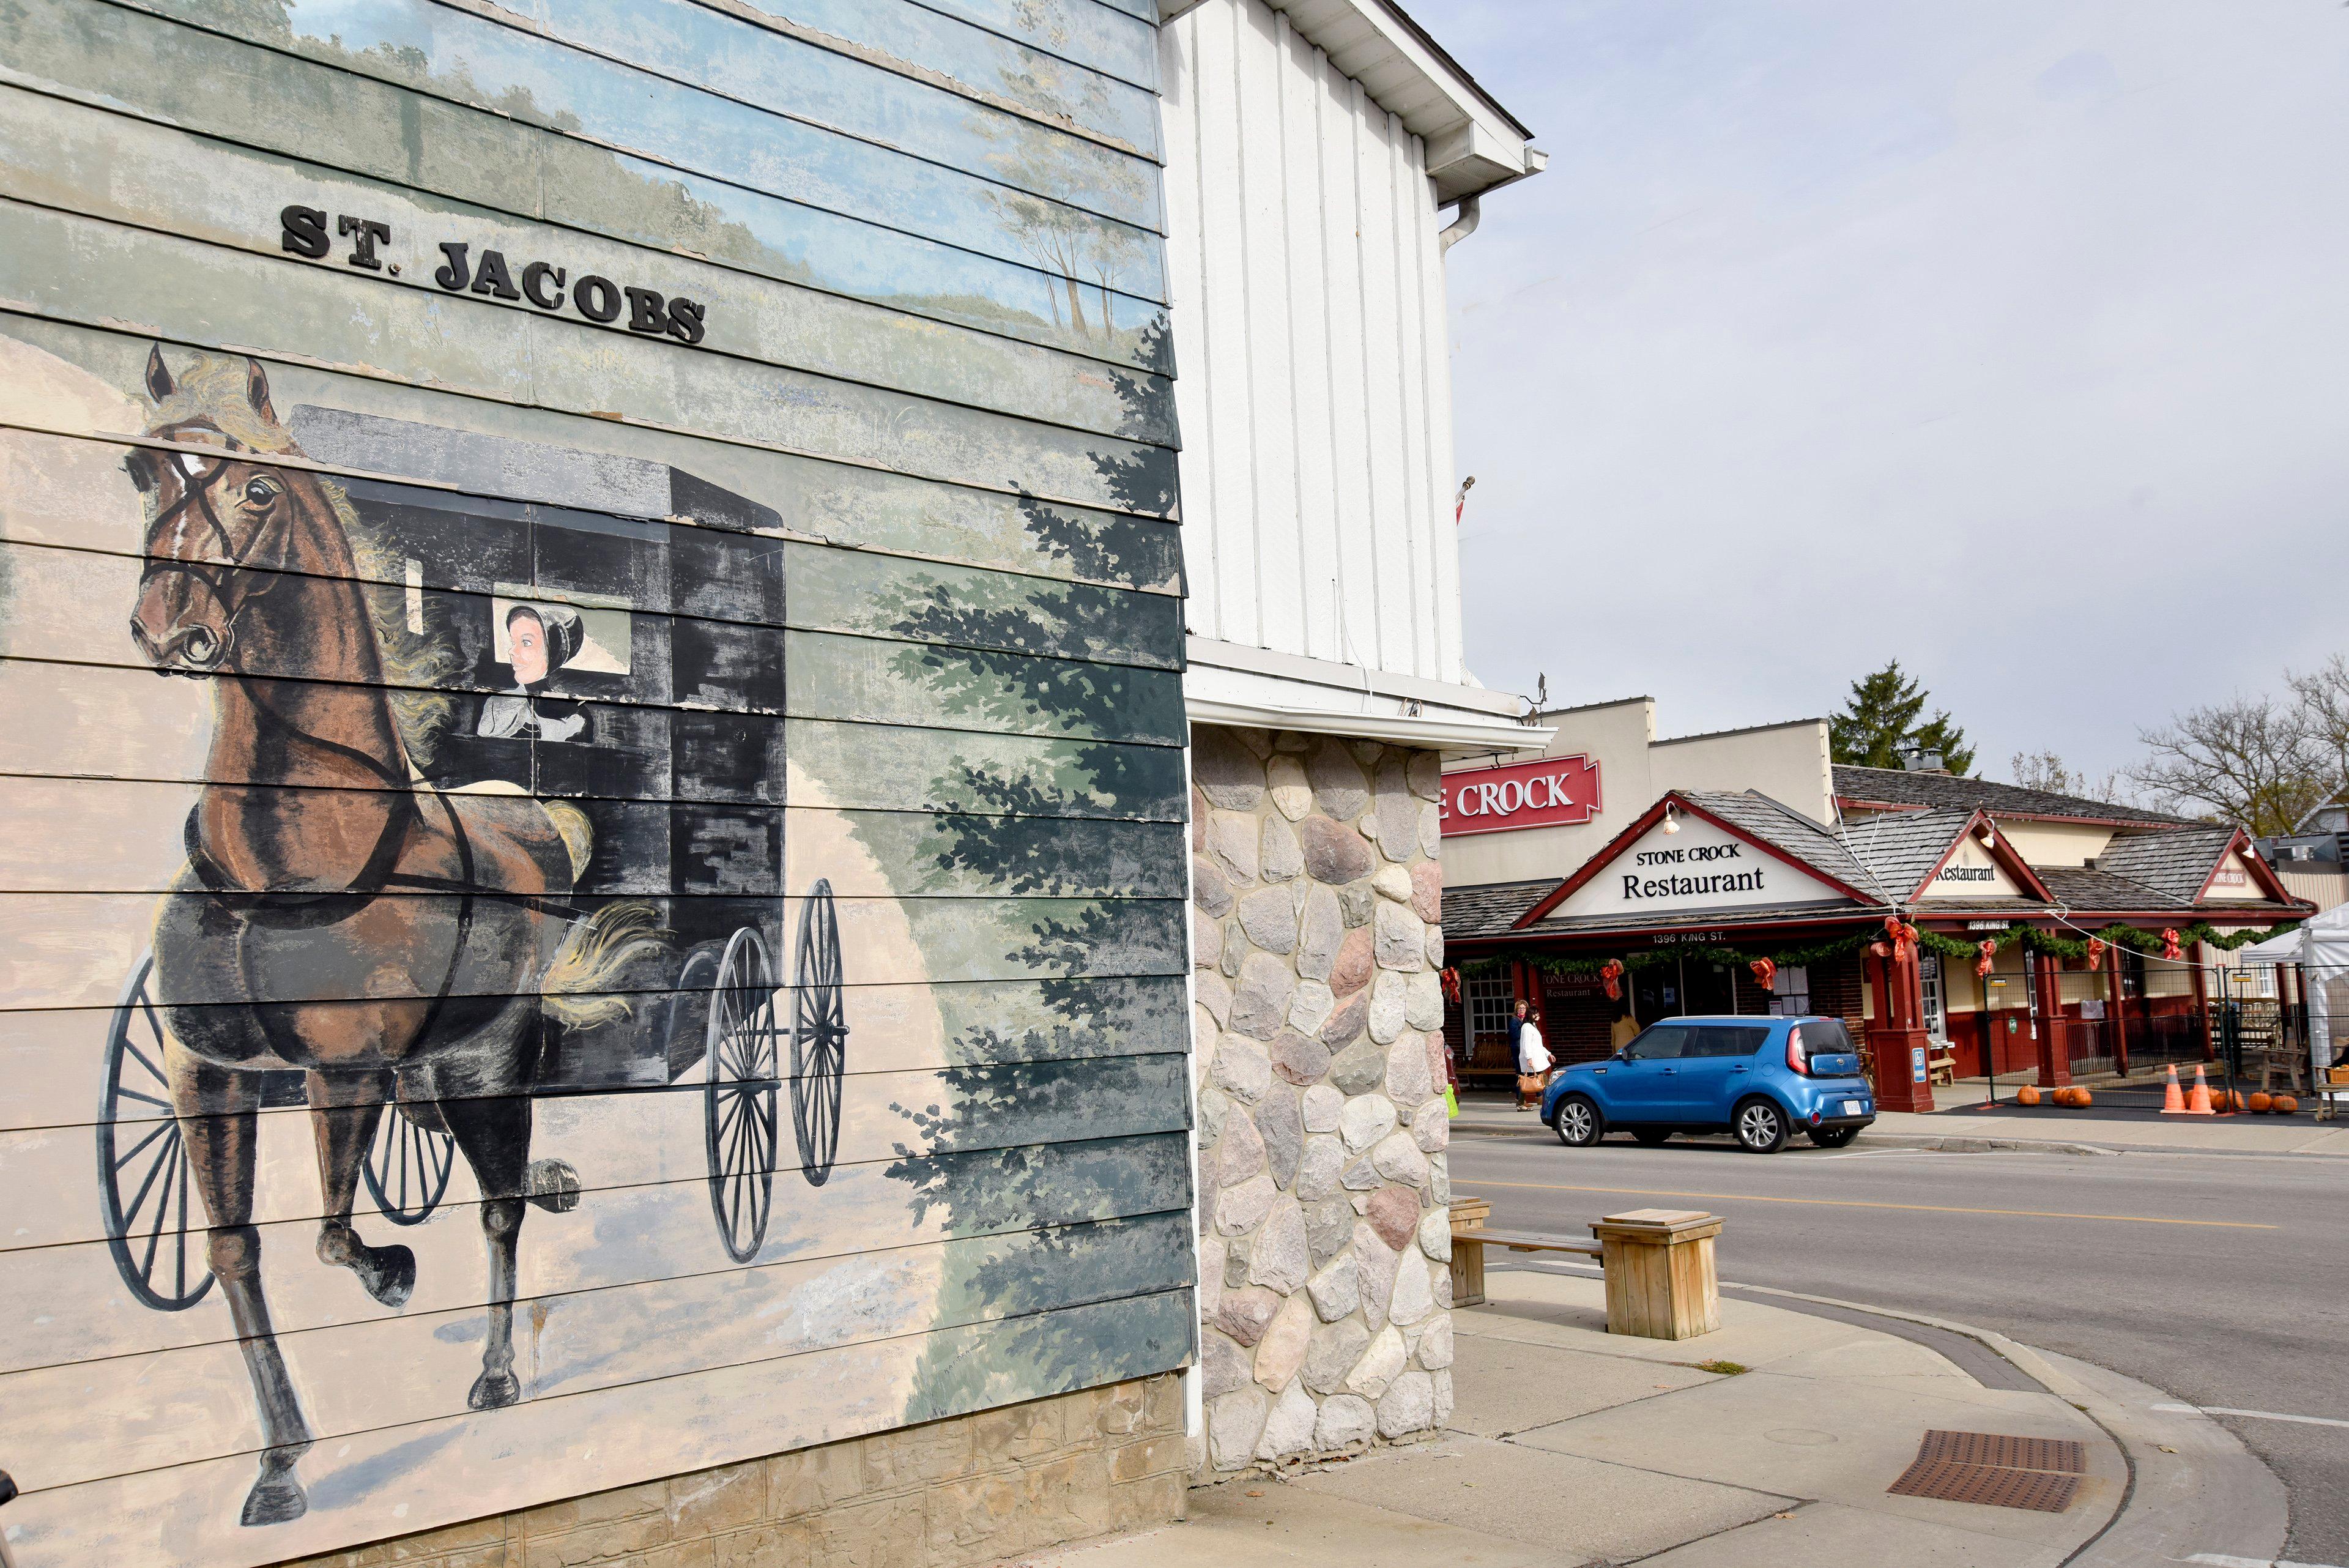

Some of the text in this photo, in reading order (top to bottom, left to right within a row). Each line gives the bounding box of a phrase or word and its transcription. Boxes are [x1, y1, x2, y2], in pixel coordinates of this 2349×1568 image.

[280, 204, 706, 344] ST. JACOBS
[1457, 773, 1575, 816] CROCK
[1636, 844, 1742, 866] STONE CROCK
[1621, 867, 1765, 899] Restaurant
[1968, 920, 2010, 930] 1396 KING ST.
[1653, 931, 1726, 943] 1396 KING ST.
[1542, 973, 1600, 984] TONE CROCK
[1546, 989, 1591, 997] Restaurant
